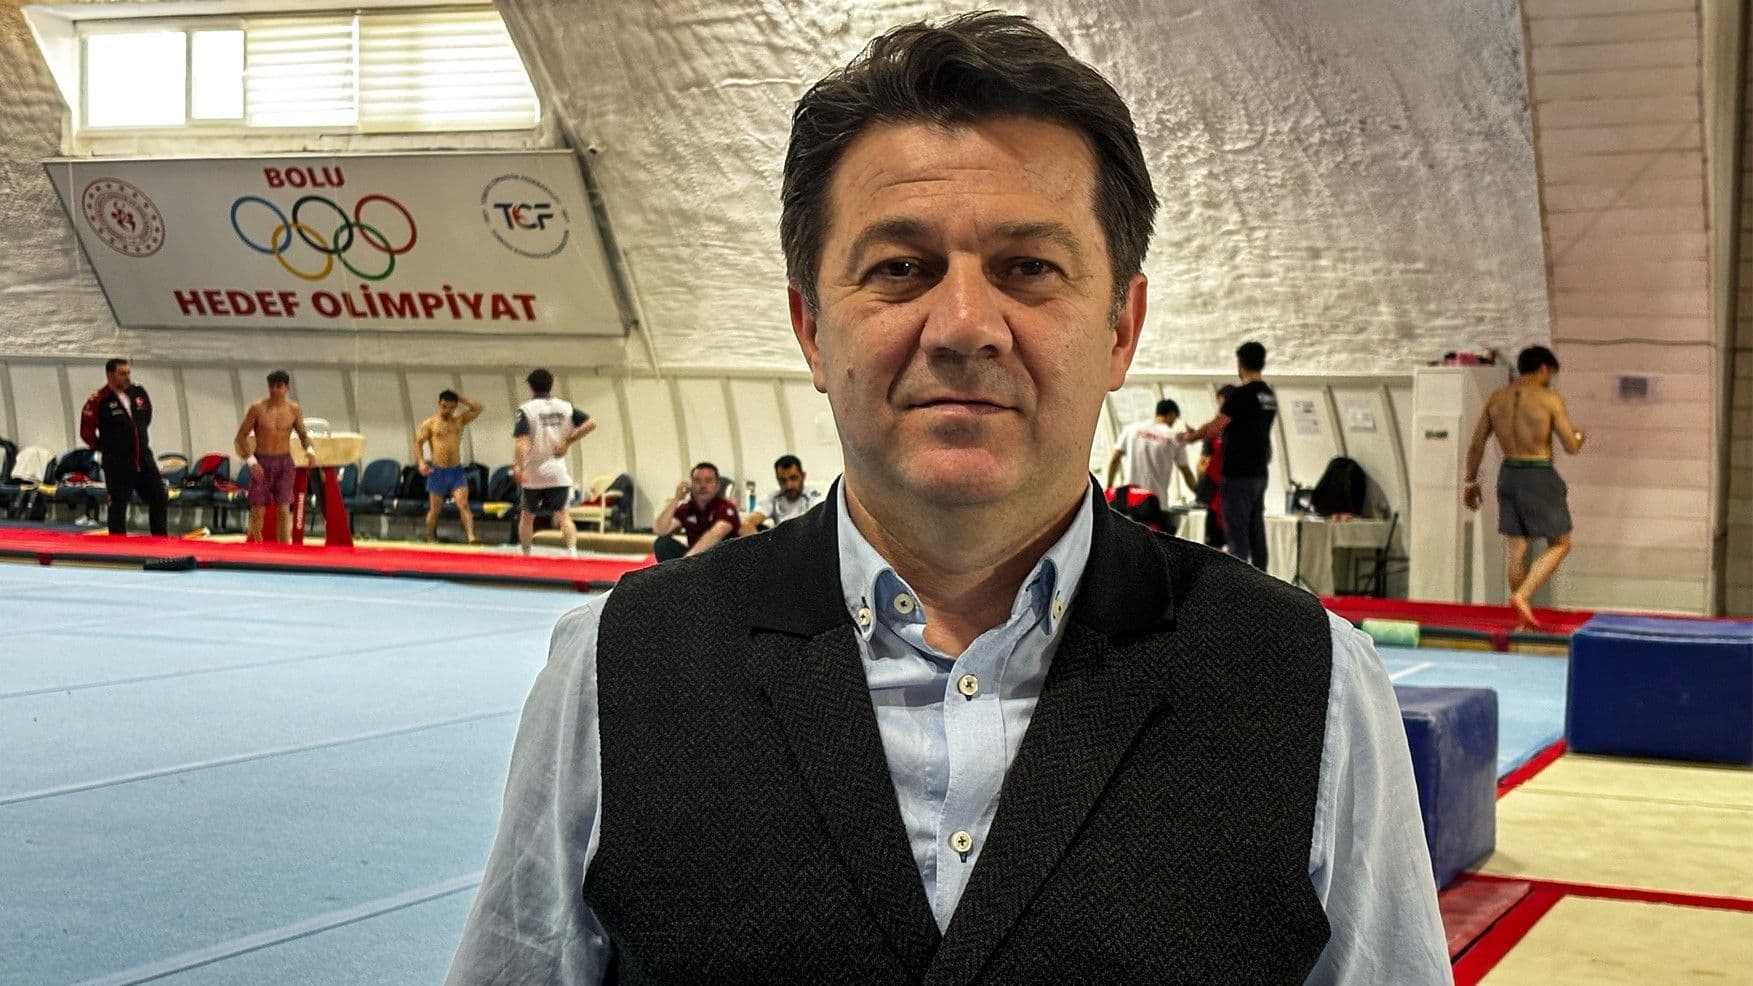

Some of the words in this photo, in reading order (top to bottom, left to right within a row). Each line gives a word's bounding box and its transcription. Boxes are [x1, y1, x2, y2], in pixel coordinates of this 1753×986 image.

[264, 167, 345, 188] BOLU
[174, 289, 300, 318] HEDEF
[311, 284, 537, 321] OLİMPİYAT
